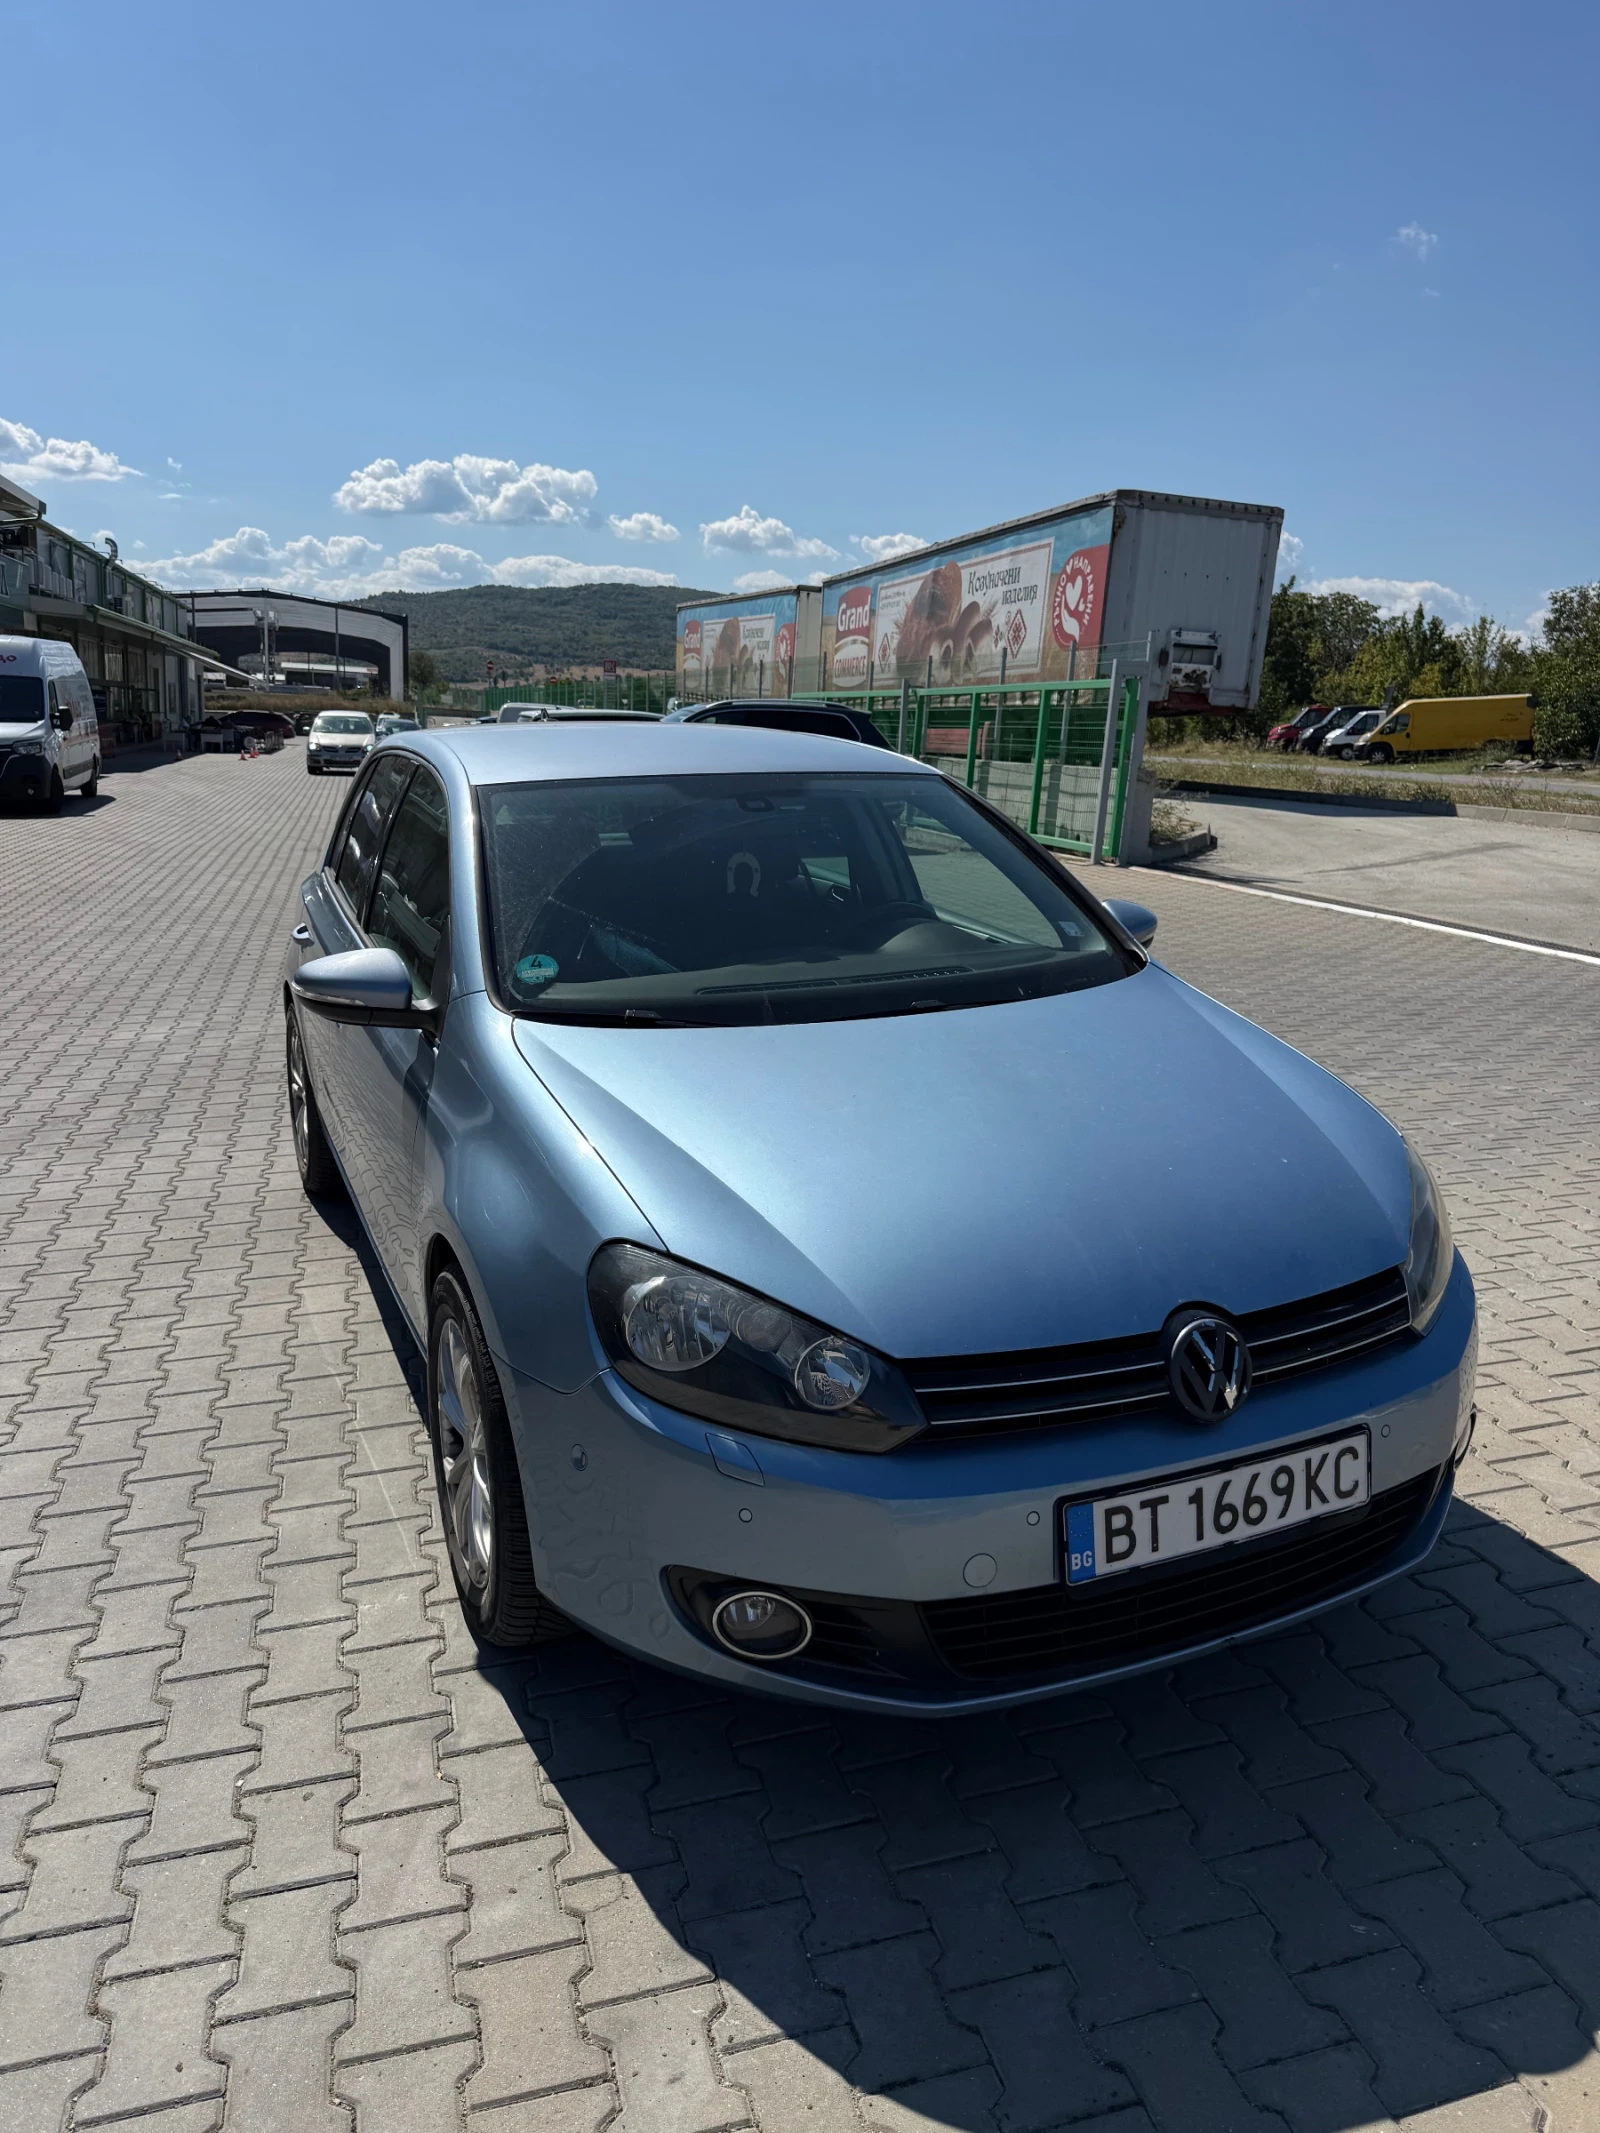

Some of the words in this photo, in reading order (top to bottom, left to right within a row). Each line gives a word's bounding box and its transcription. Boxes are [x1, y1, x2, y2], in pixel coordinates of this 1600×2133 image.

[967, 566, 1021, 596] Козуначени
[1073, 556, 1094, 626] НАПРАВЕНИ
[1001, 584, 1038, 606] изделия
[837, 594, 871, 632] Grand
[531, 955, 543, 968] 4
[1071, 1550, 1093, 1571] BG
